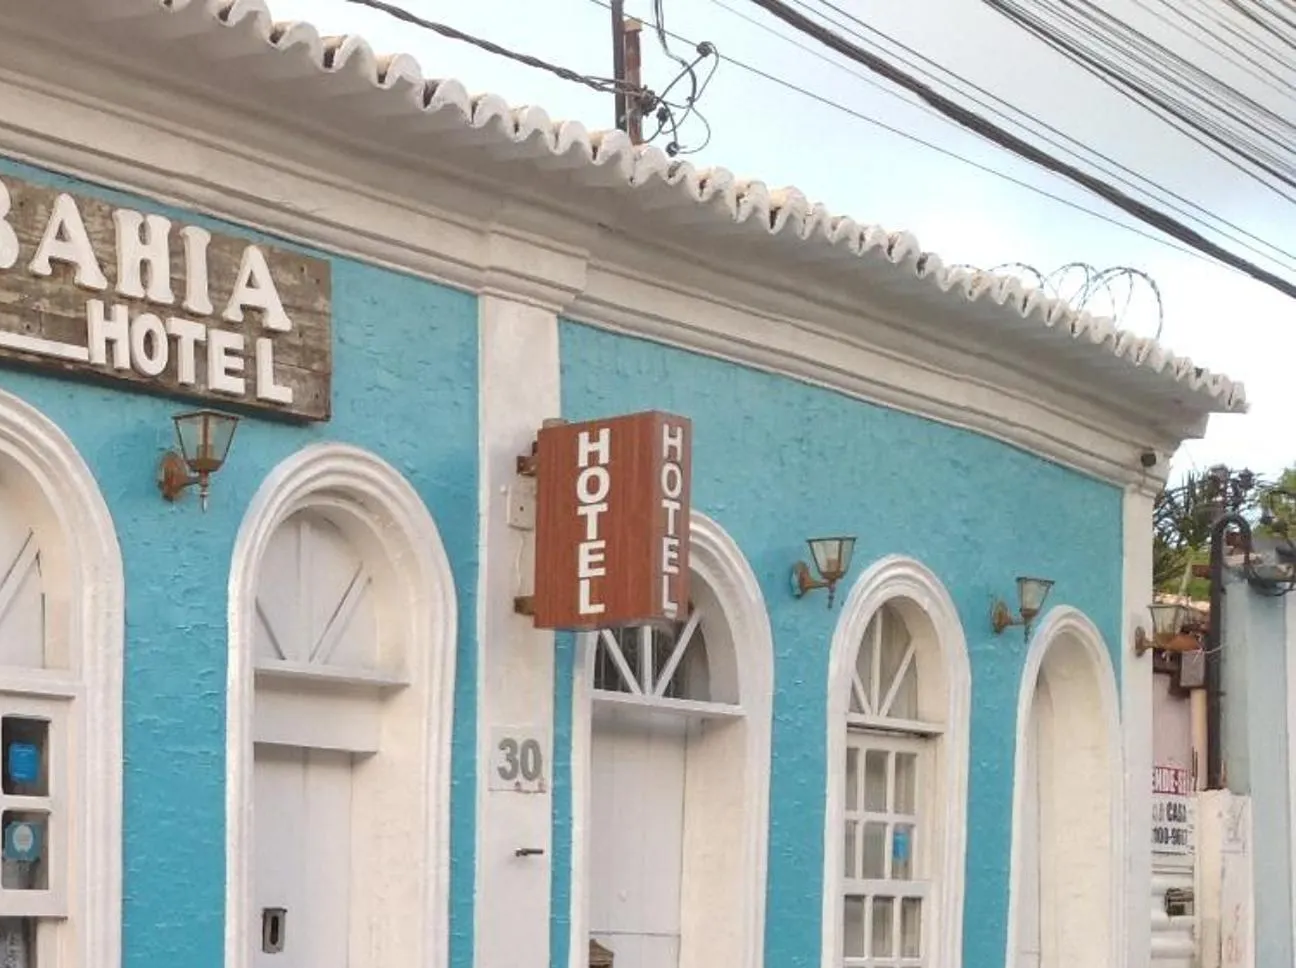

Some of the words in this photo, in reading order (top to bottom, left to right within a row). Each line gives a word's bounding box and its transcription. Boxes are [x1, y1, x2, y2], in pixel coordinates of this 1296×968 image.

[86, 299, 294, 404] HOTEL
[576, 427, 611, 615] HOTEL
[661, 423, 684, 616] HOTEL
[497, 737, 543, 781] 30
